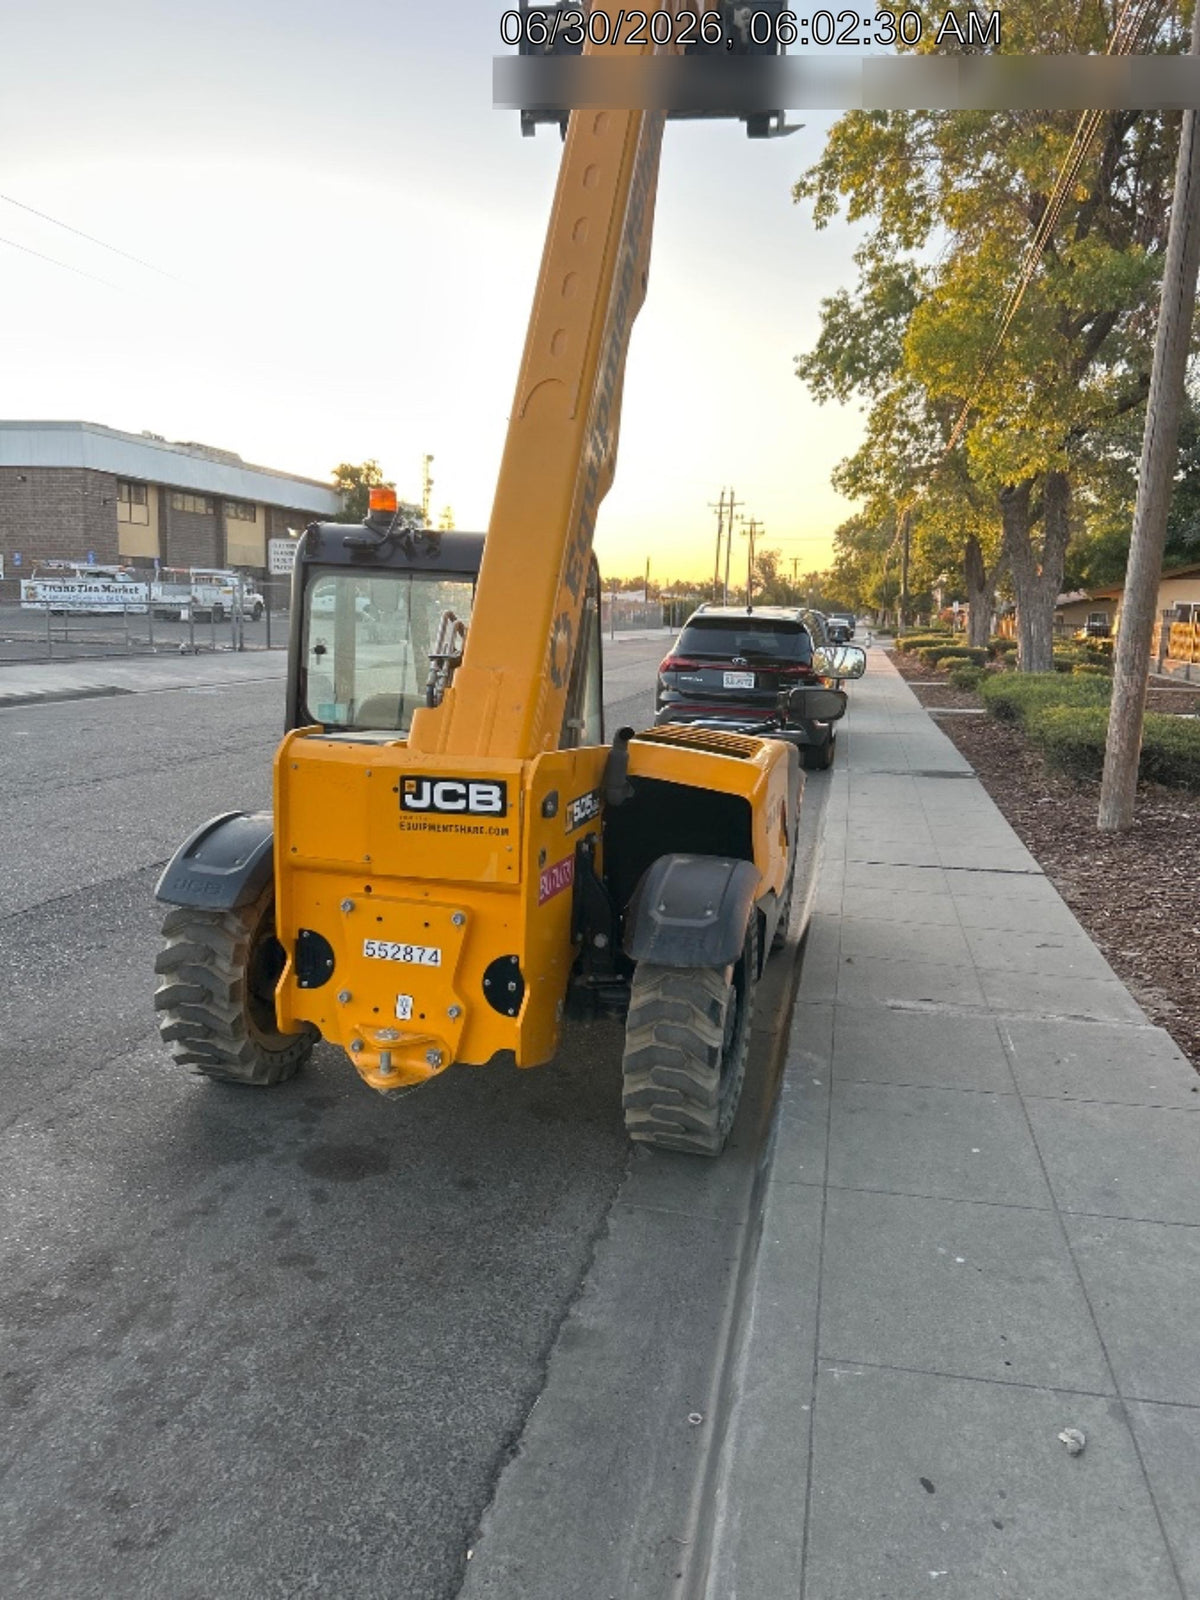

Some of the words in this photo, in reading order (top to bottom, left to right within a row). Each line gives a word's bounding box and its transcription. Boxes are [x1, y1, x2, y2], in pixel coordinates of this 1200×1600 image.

[101, 584, 139, 595] Market
[404, 780, 503, 812] JCB
[365, 940, 439, 965] 552874
